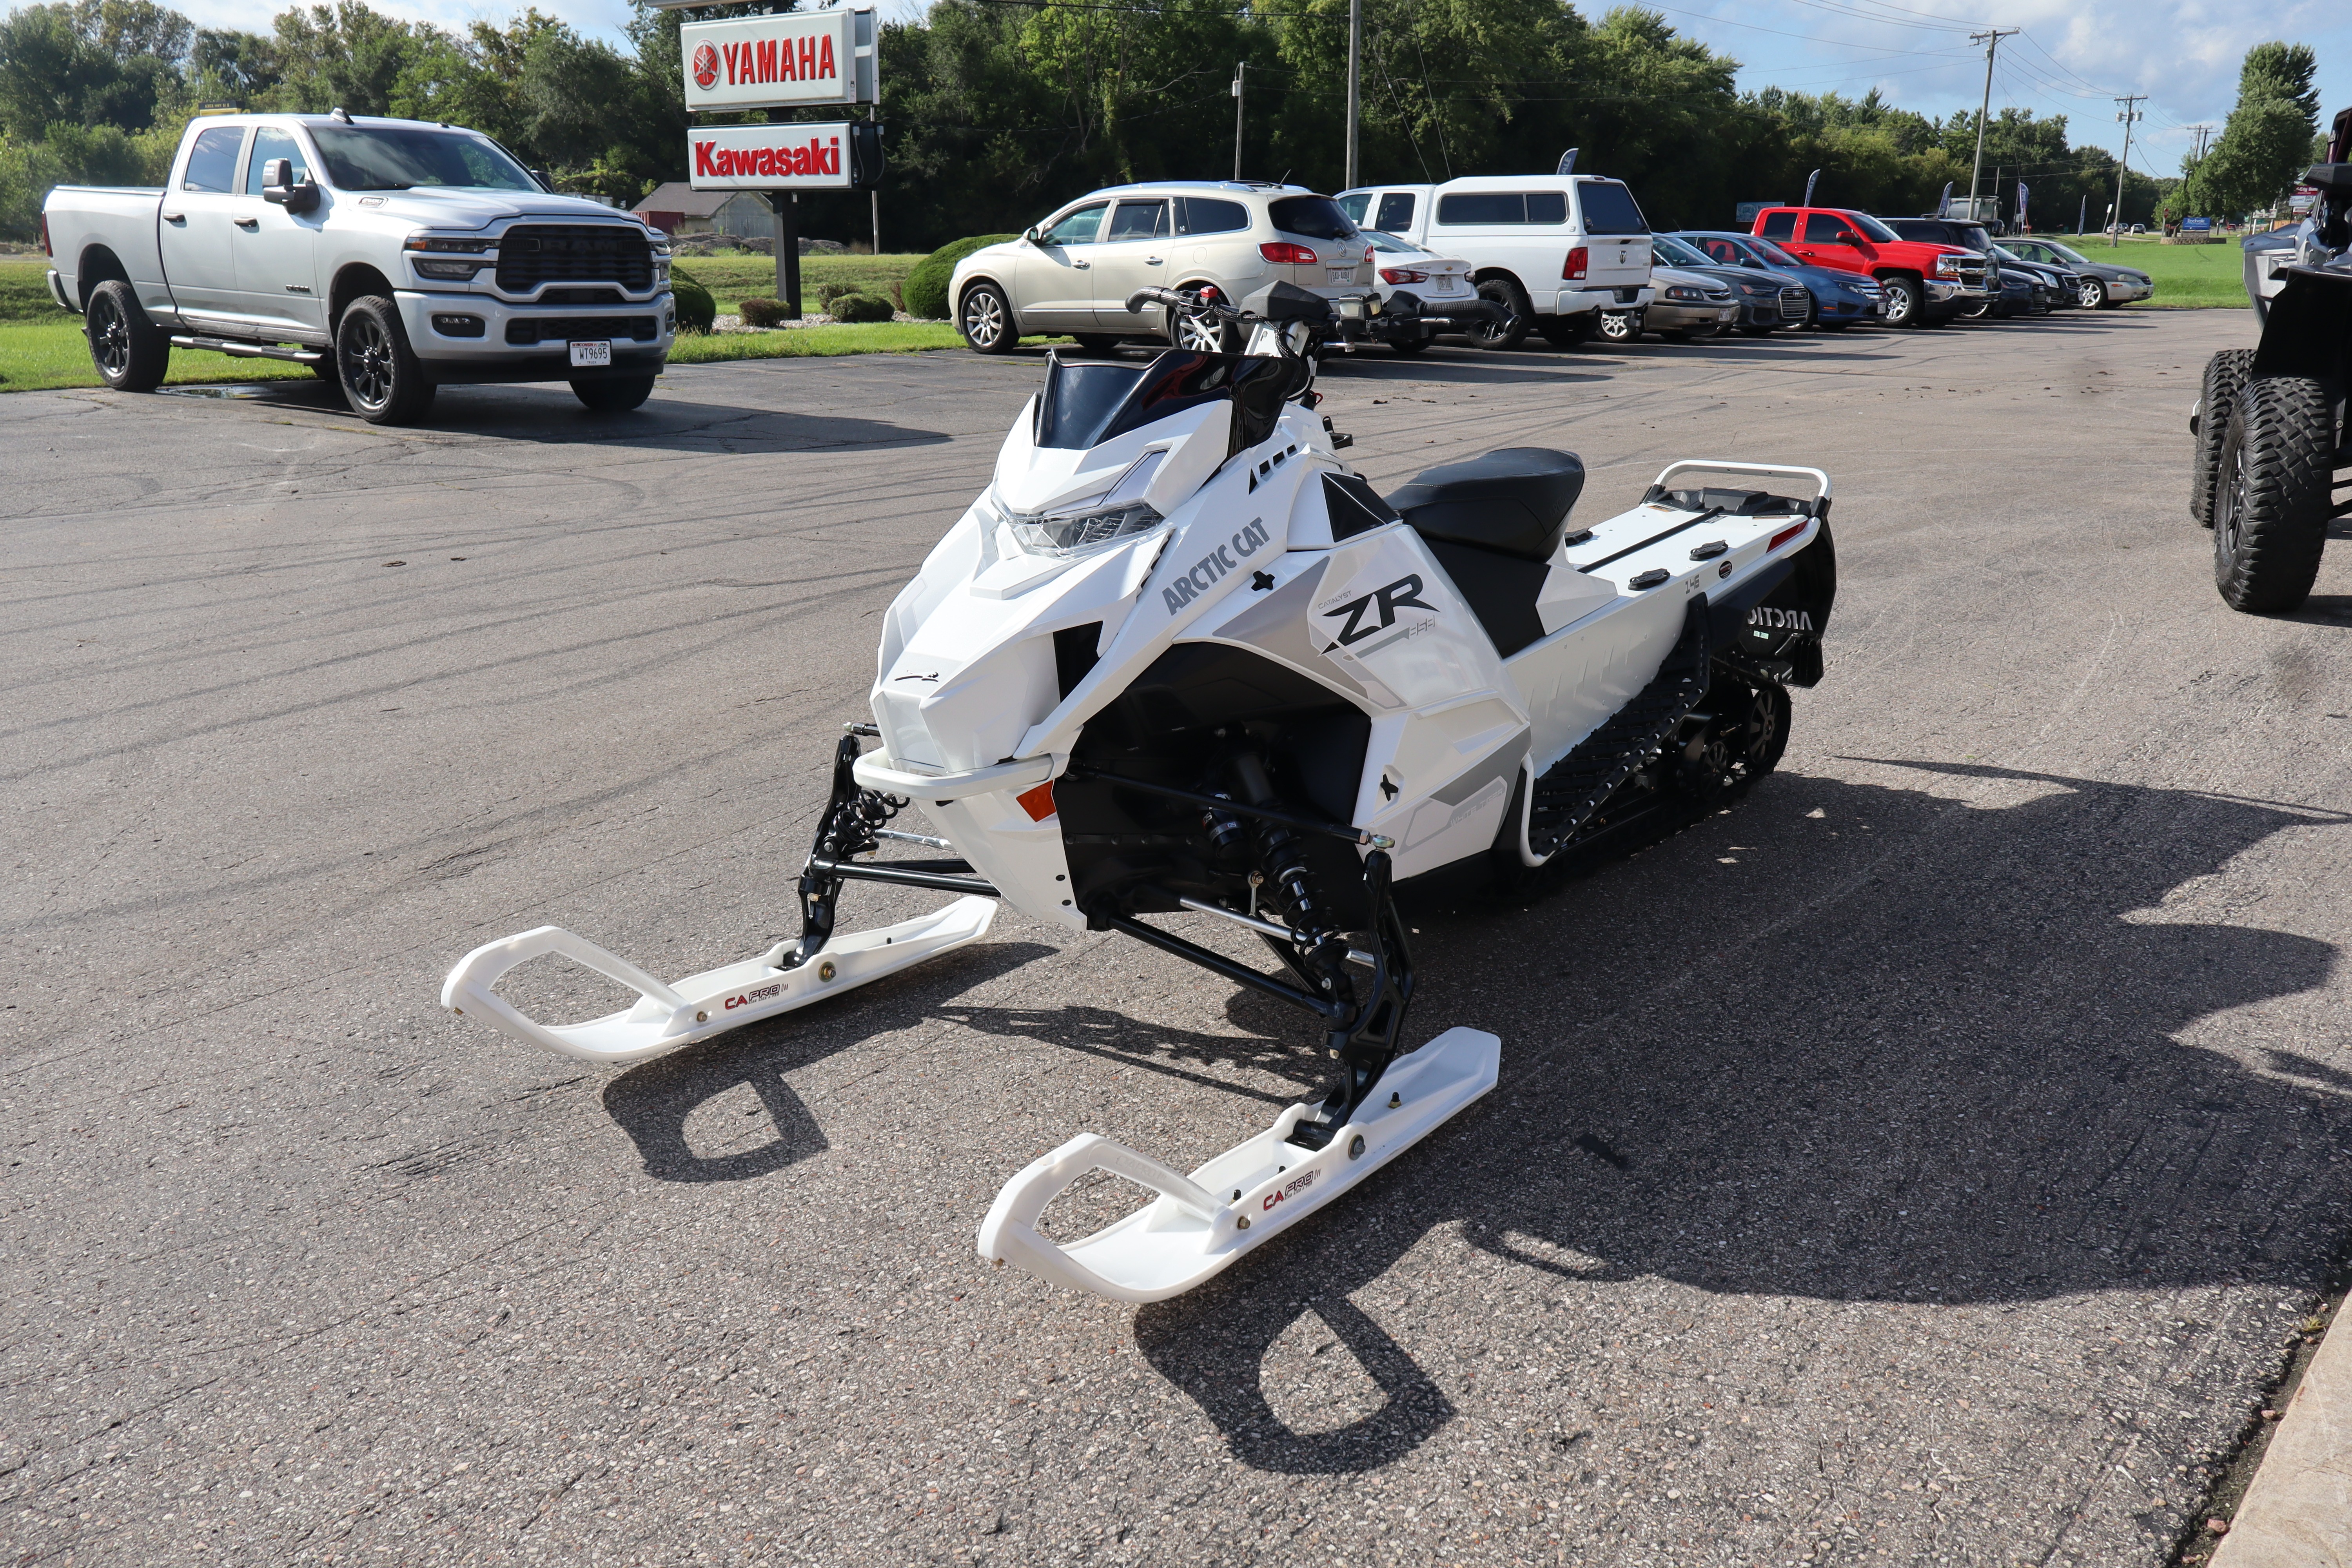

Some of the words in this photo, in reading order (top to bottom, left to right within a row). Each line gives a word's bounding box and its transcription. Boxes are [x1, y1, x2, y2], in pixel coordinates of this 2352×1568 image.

[721, 34, 836, 85] YAMAHA
[695, 136, 840, 176] Kawasaki
[1562, 156, 1572, 175] ALE
[579, 347, 607, 359] WT9695
[1161, 544, 1238, 616] ARCTIC
[1232, 516, 1270, 557] CAT
[1685, 573, 1700, 595] 146
[1318, 590, 1351, 609] CATALYST
[1319, 573, 1441, 656] ZR
[1450, 805, 1477, 827] WHITE
[1480, 788, 1503, 808] TIGER
[749, 984, 780, 1001] PRO
[1285, 1171, 1314, 1196] PRO
